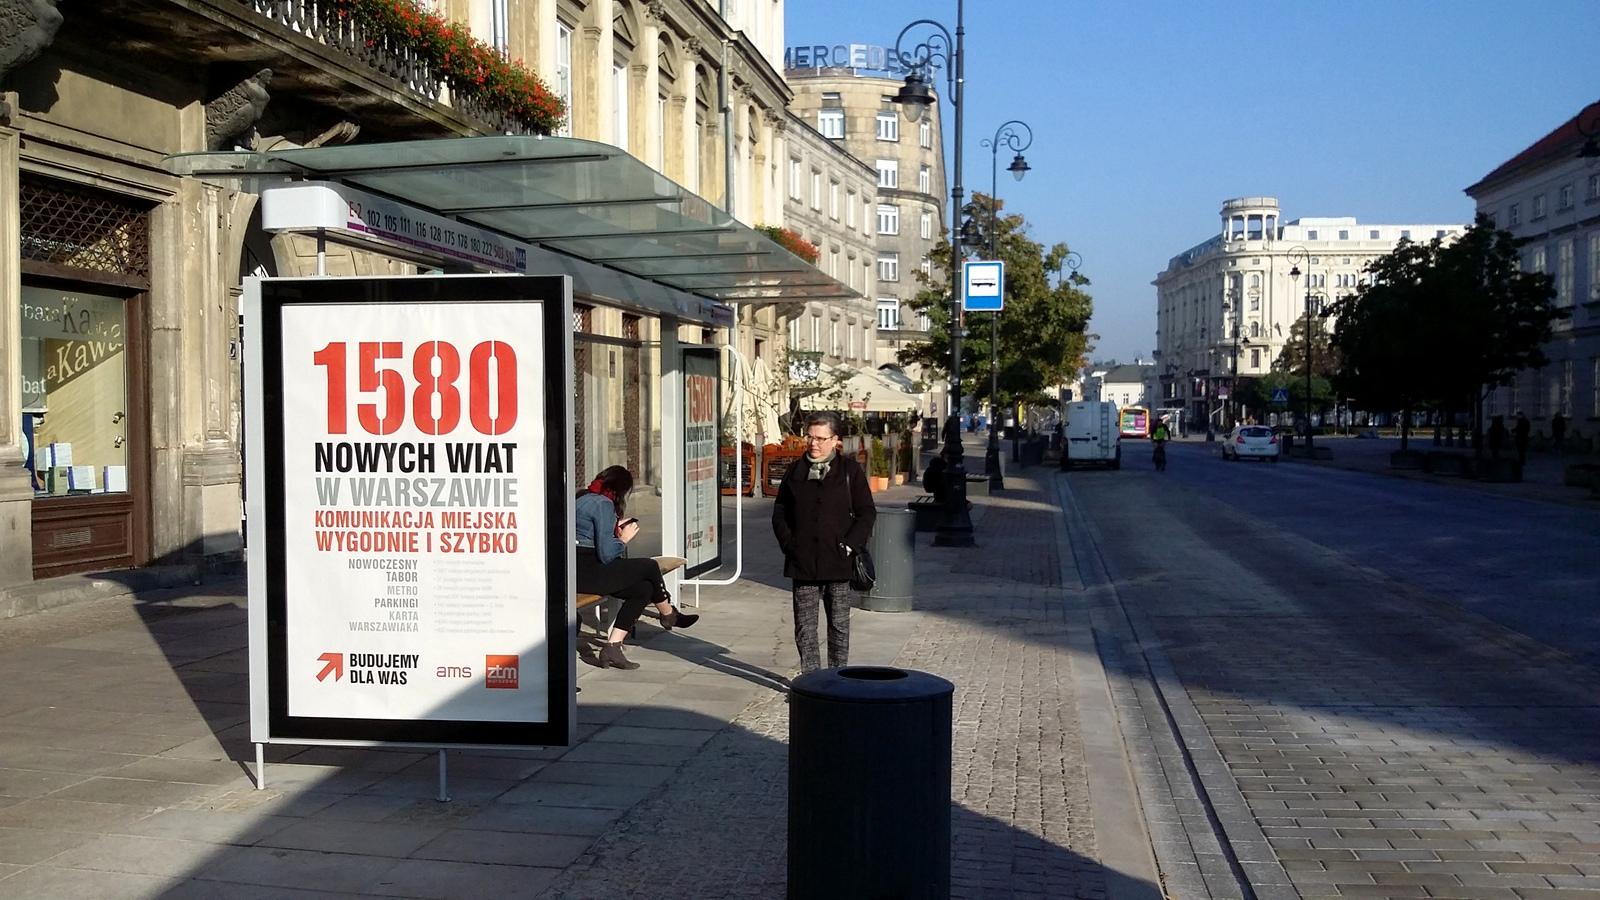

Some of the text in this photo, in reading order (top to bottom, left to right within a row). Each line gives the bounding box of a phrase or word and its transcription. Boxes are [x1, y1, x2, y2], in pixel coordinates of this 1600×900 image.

[367, 210, 381, 228] 102
[384, 214, 397, 232] 105
[400, 217, 411, 233] 111
[415, 221, 427, 238] 116
[430, 225, 442, 242] 128
[444, 230, 455, 246] 175
[457, 233, 468, 249] 178
[470, 238, 480, 253] 180
[482, 241, 492, 256] 222
[313, 340, 518, 435] 1580
[315, 442, 518, 473] NOWYCH WIAT
[316, 478, 518, 507] W WARSZAWIE
[315, 511, 518, 529] KOMUNIKACJA MIEJSKA
[315, 532, 518, 553] WYGODNIE I SZYBKO
[348, 559, 418, 570] NOWOCZESNY
[386, 571, 418, 583] TABOR
[387, 585, 418, 596] METRO
[374, 598, 419, 609] PARKINGI
[388, 611, 419, 621] KARTA
[349, 621, 419, 632] WARSZAWIAKA
[349, 653, 420, 670] BUDUJEMY
[350, 669, 408, 685] DLA WAS
[436, 665, 472, 679] ams
[487, 664, 518, 679] ztm
